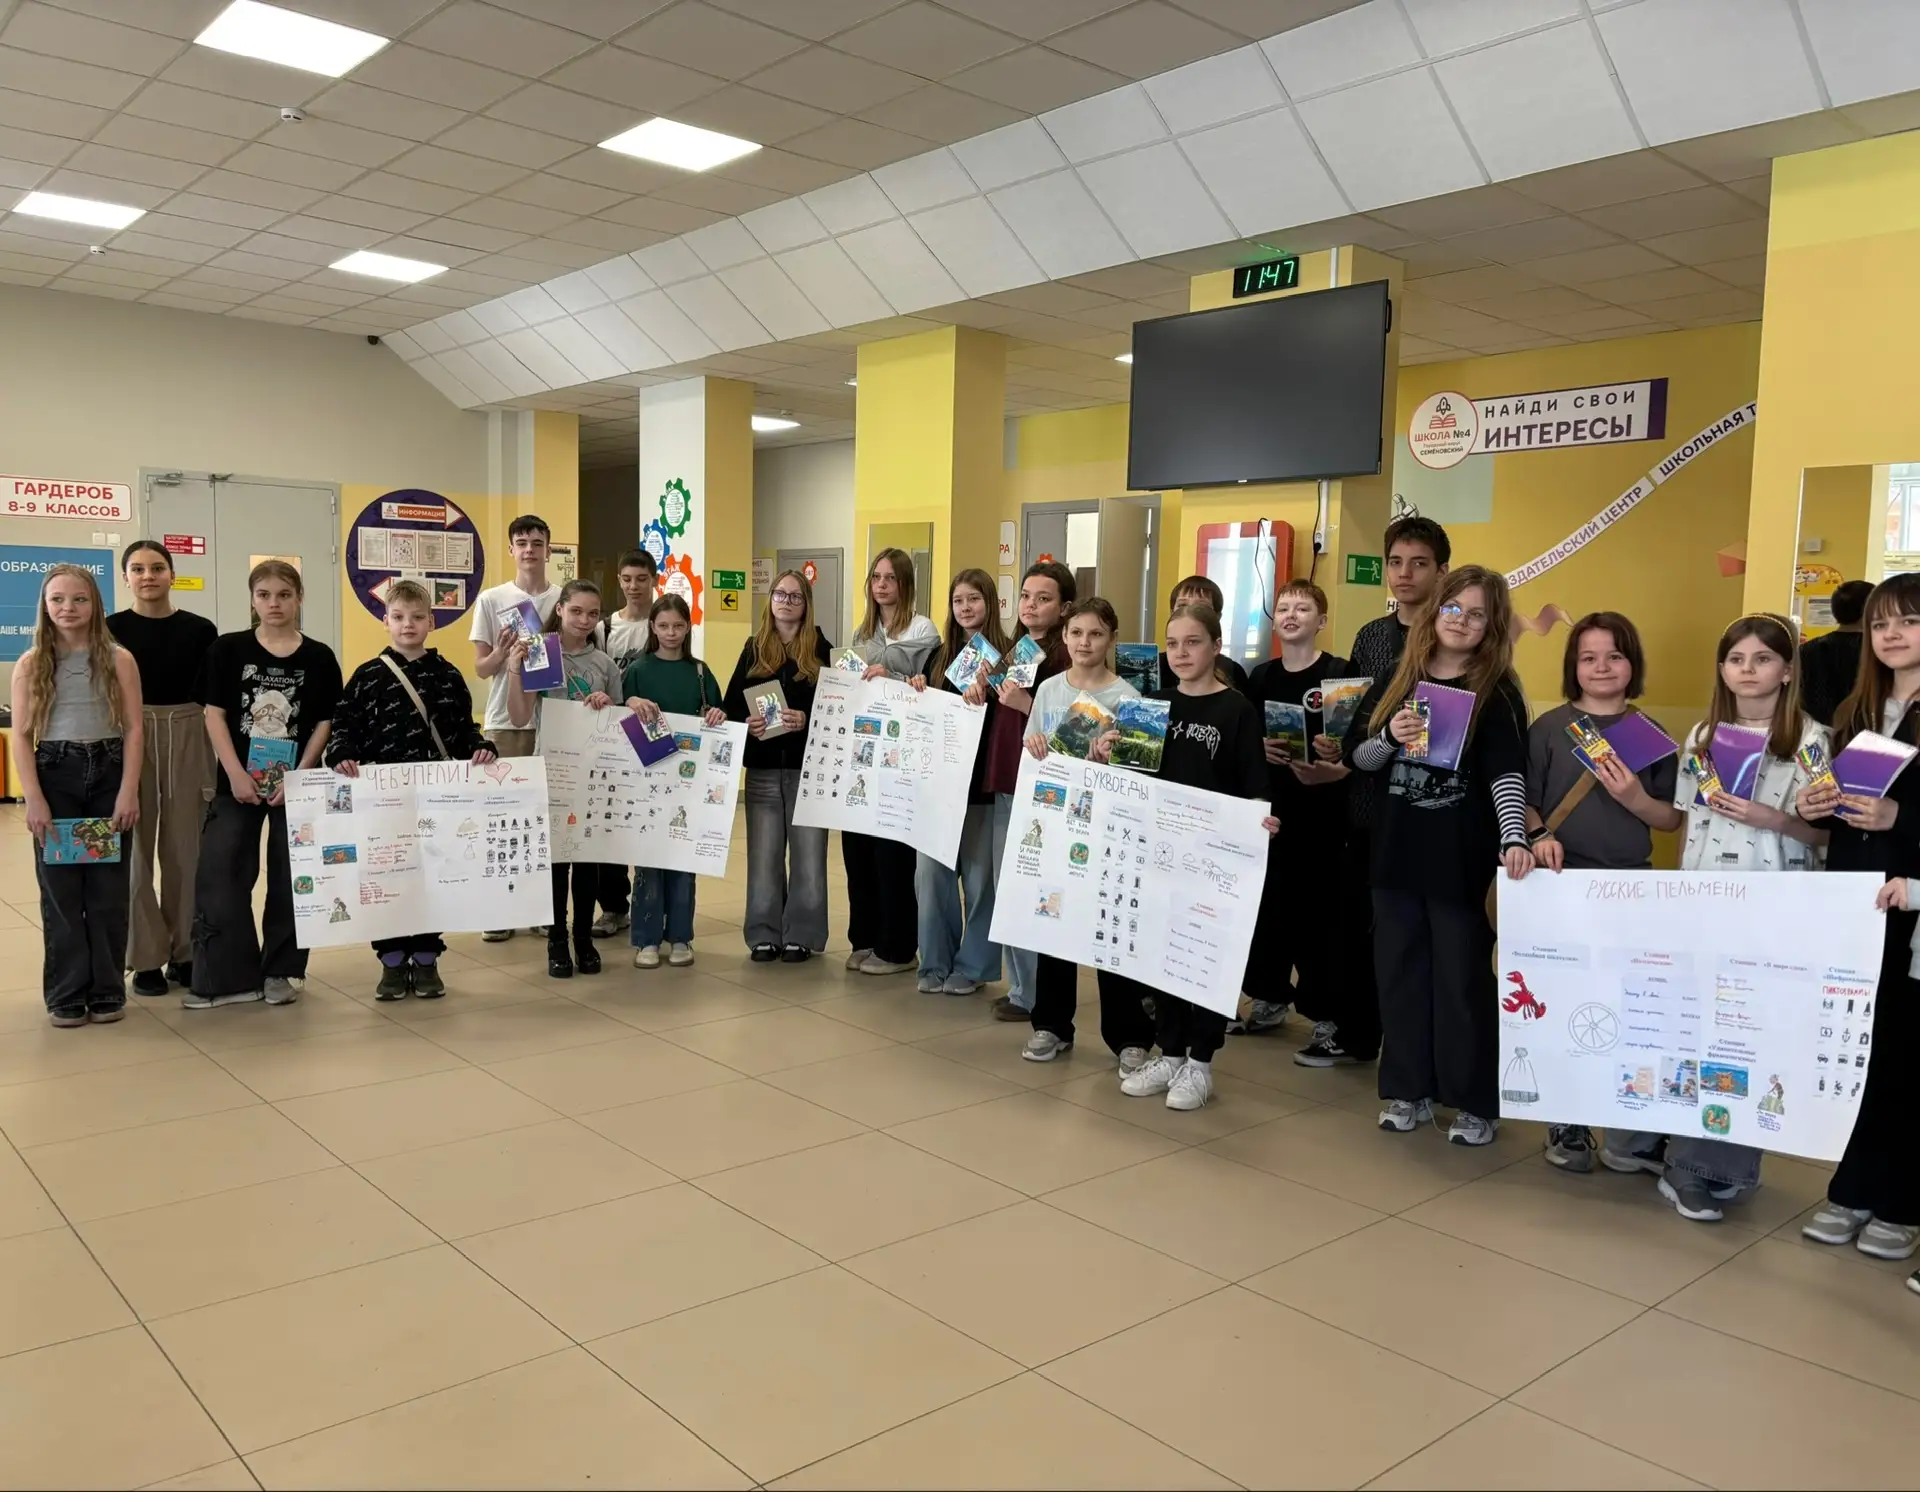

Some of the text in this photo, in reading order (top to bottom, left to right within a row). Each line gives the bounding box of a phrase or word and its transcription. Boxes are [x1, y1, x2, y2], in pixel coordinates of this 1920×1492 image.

[1244, 260, 1295, 292] 11:47
[1484, 390, 1636, 418] НАЙДИ СВОИ
[1414, 428, 1472, 443] ШКОЛА №4
[1484, 414, 1633, 449] ИНТЕРЕСЫ
[1659, 411, 1745, 477] ШКОЛЬНАЯ
[14, 481, 114, 500] ГАРДЕРОБ
[8, 501, 121, 517] 8-9 КЛАССОВ
[398, 509, 446, 518] ИНФОРМАЦИЯ
[1506, 486, 1642, 588] ЗДАТЕЛЬСКИЙ ЦЕНТР
[252, 674, 296, 685] RELAXATION
[365, 761, 470, 791] ЧЕБУПЕЛИ!
[1084, 766, 1149, 801] БУКВОЕДЫ
[1586, 879, 1747, 901] РУССКИЕ ПЕЛЬМЕНИ
